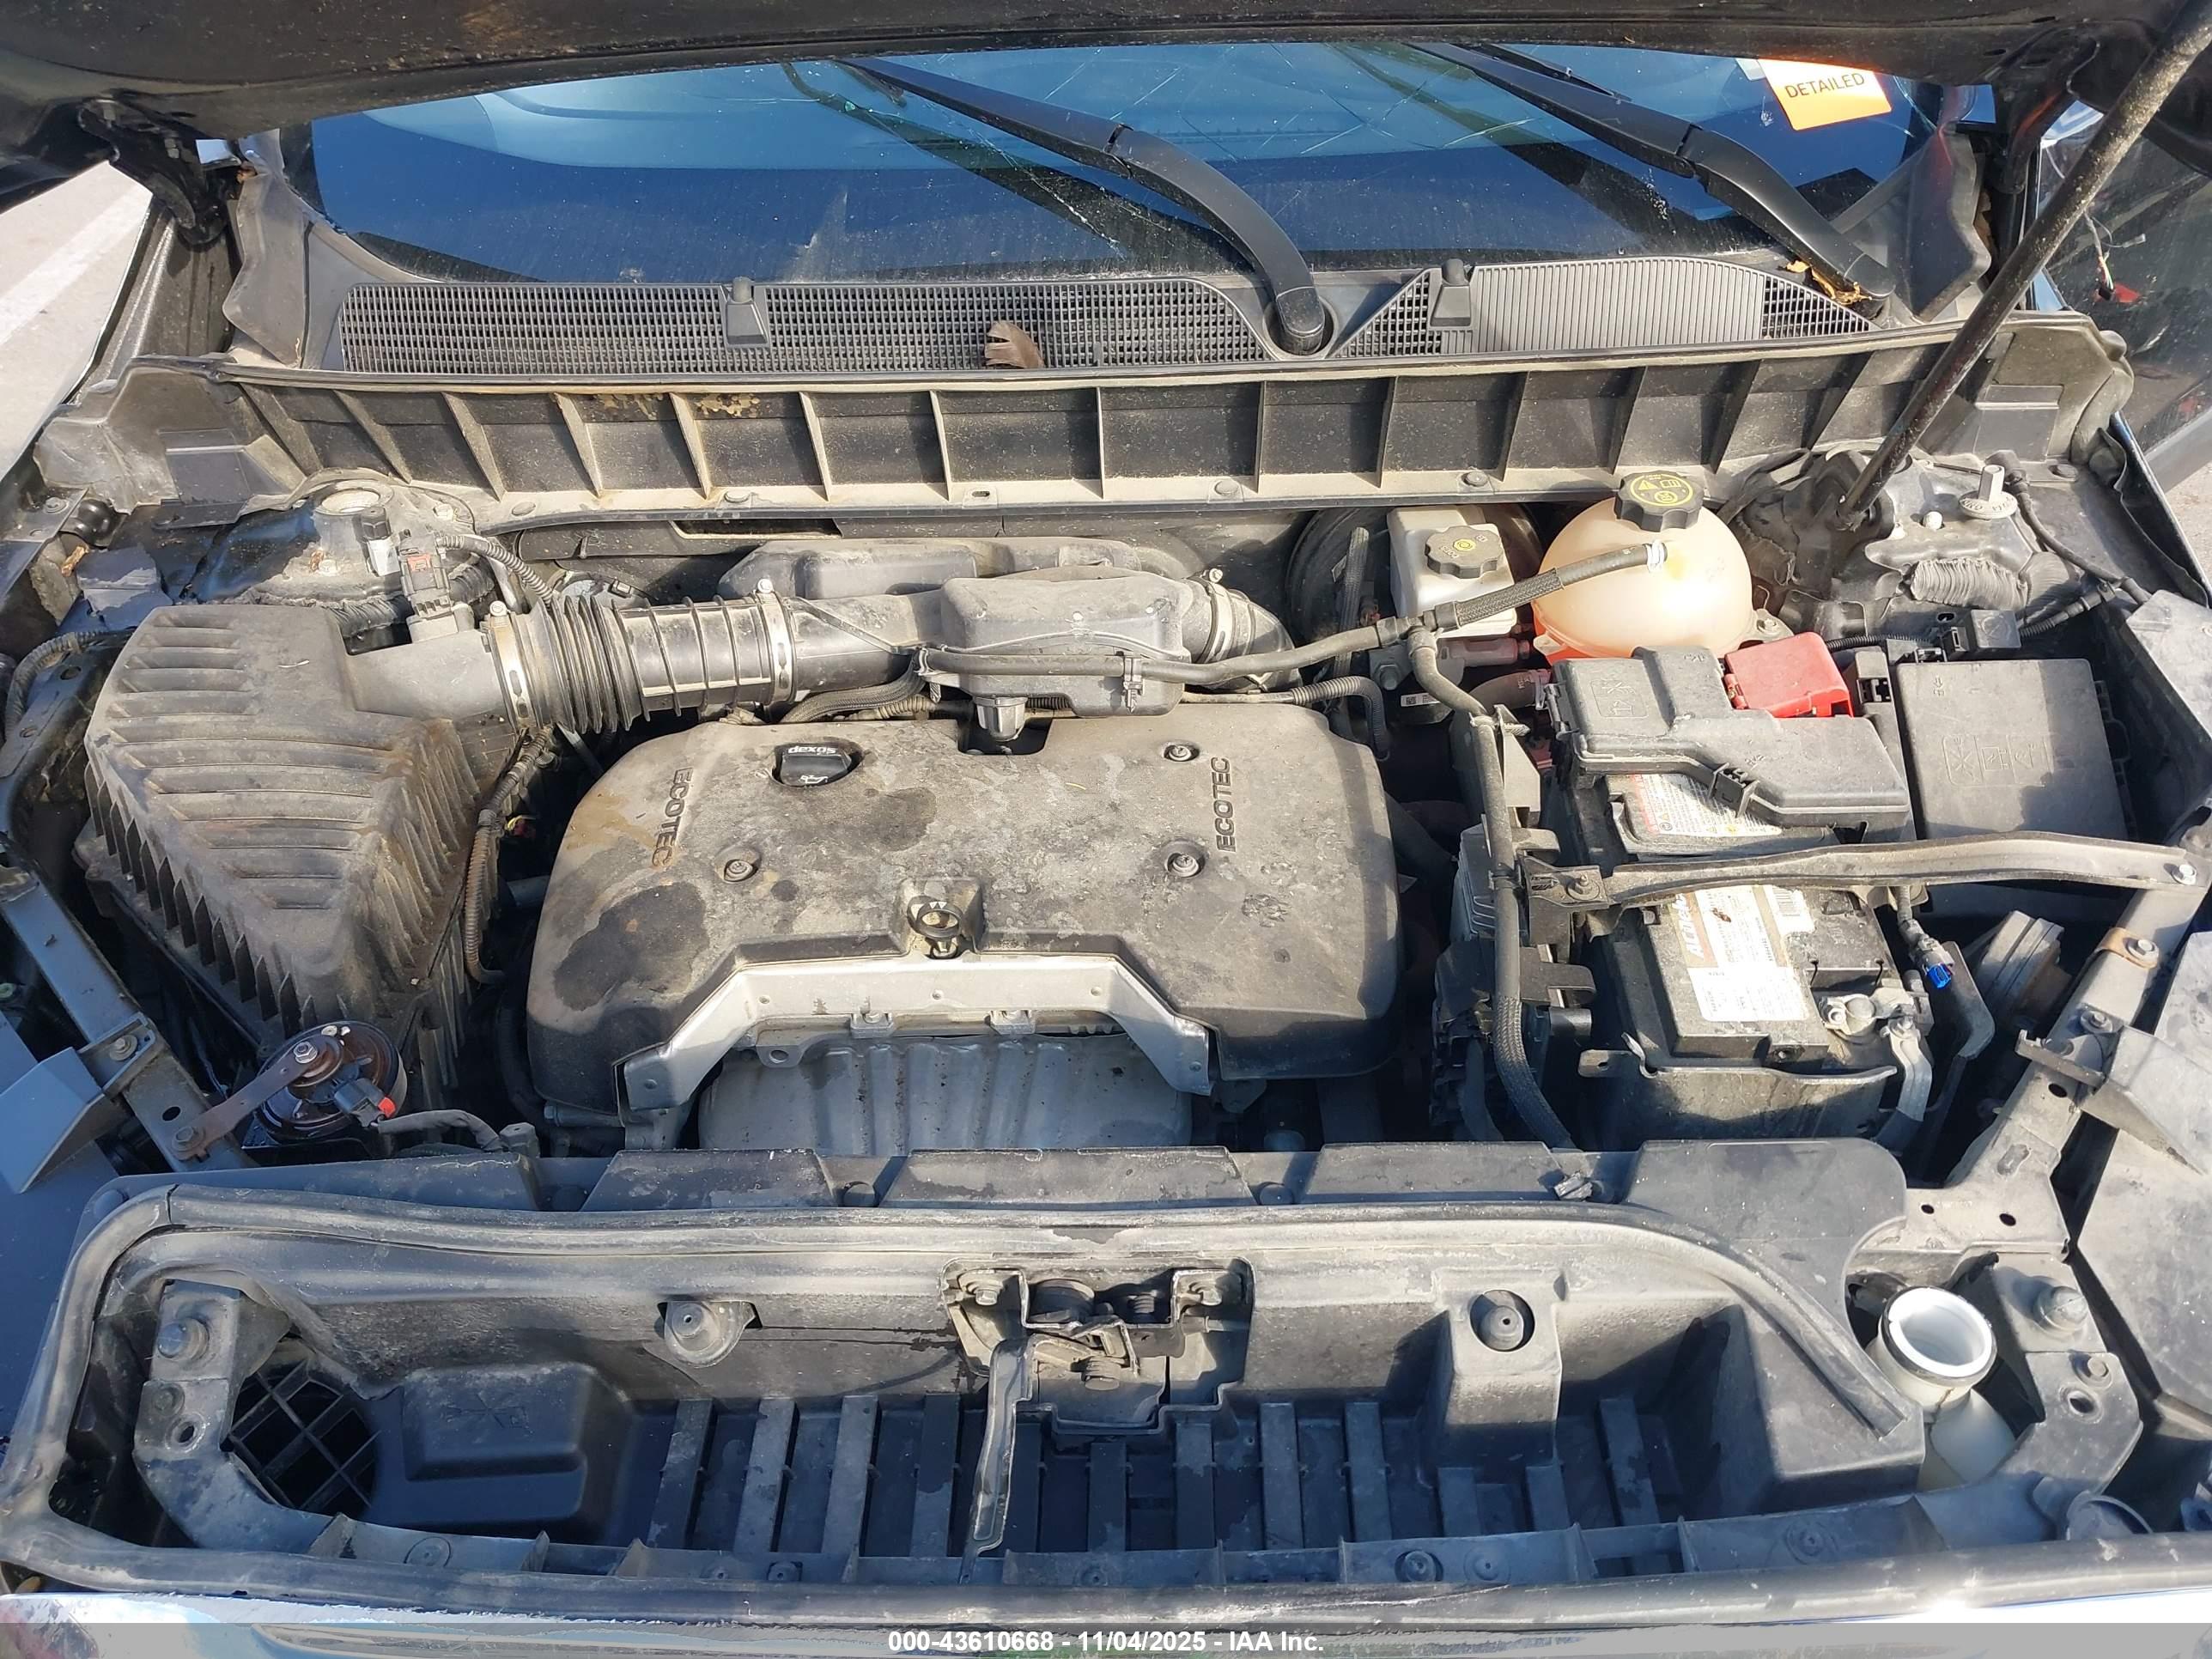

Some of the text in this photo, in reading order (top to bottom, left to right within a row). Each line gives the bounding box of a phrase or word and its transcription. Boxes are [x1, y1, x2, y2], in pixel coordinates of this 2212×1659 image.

[1784, 72, 1865, 98] DETAILED
[787, 745, 839, 756] dexos
[653, 767, 693, 866] ECOTEC
[1211, 757, 1237, 852] ECOTEC
